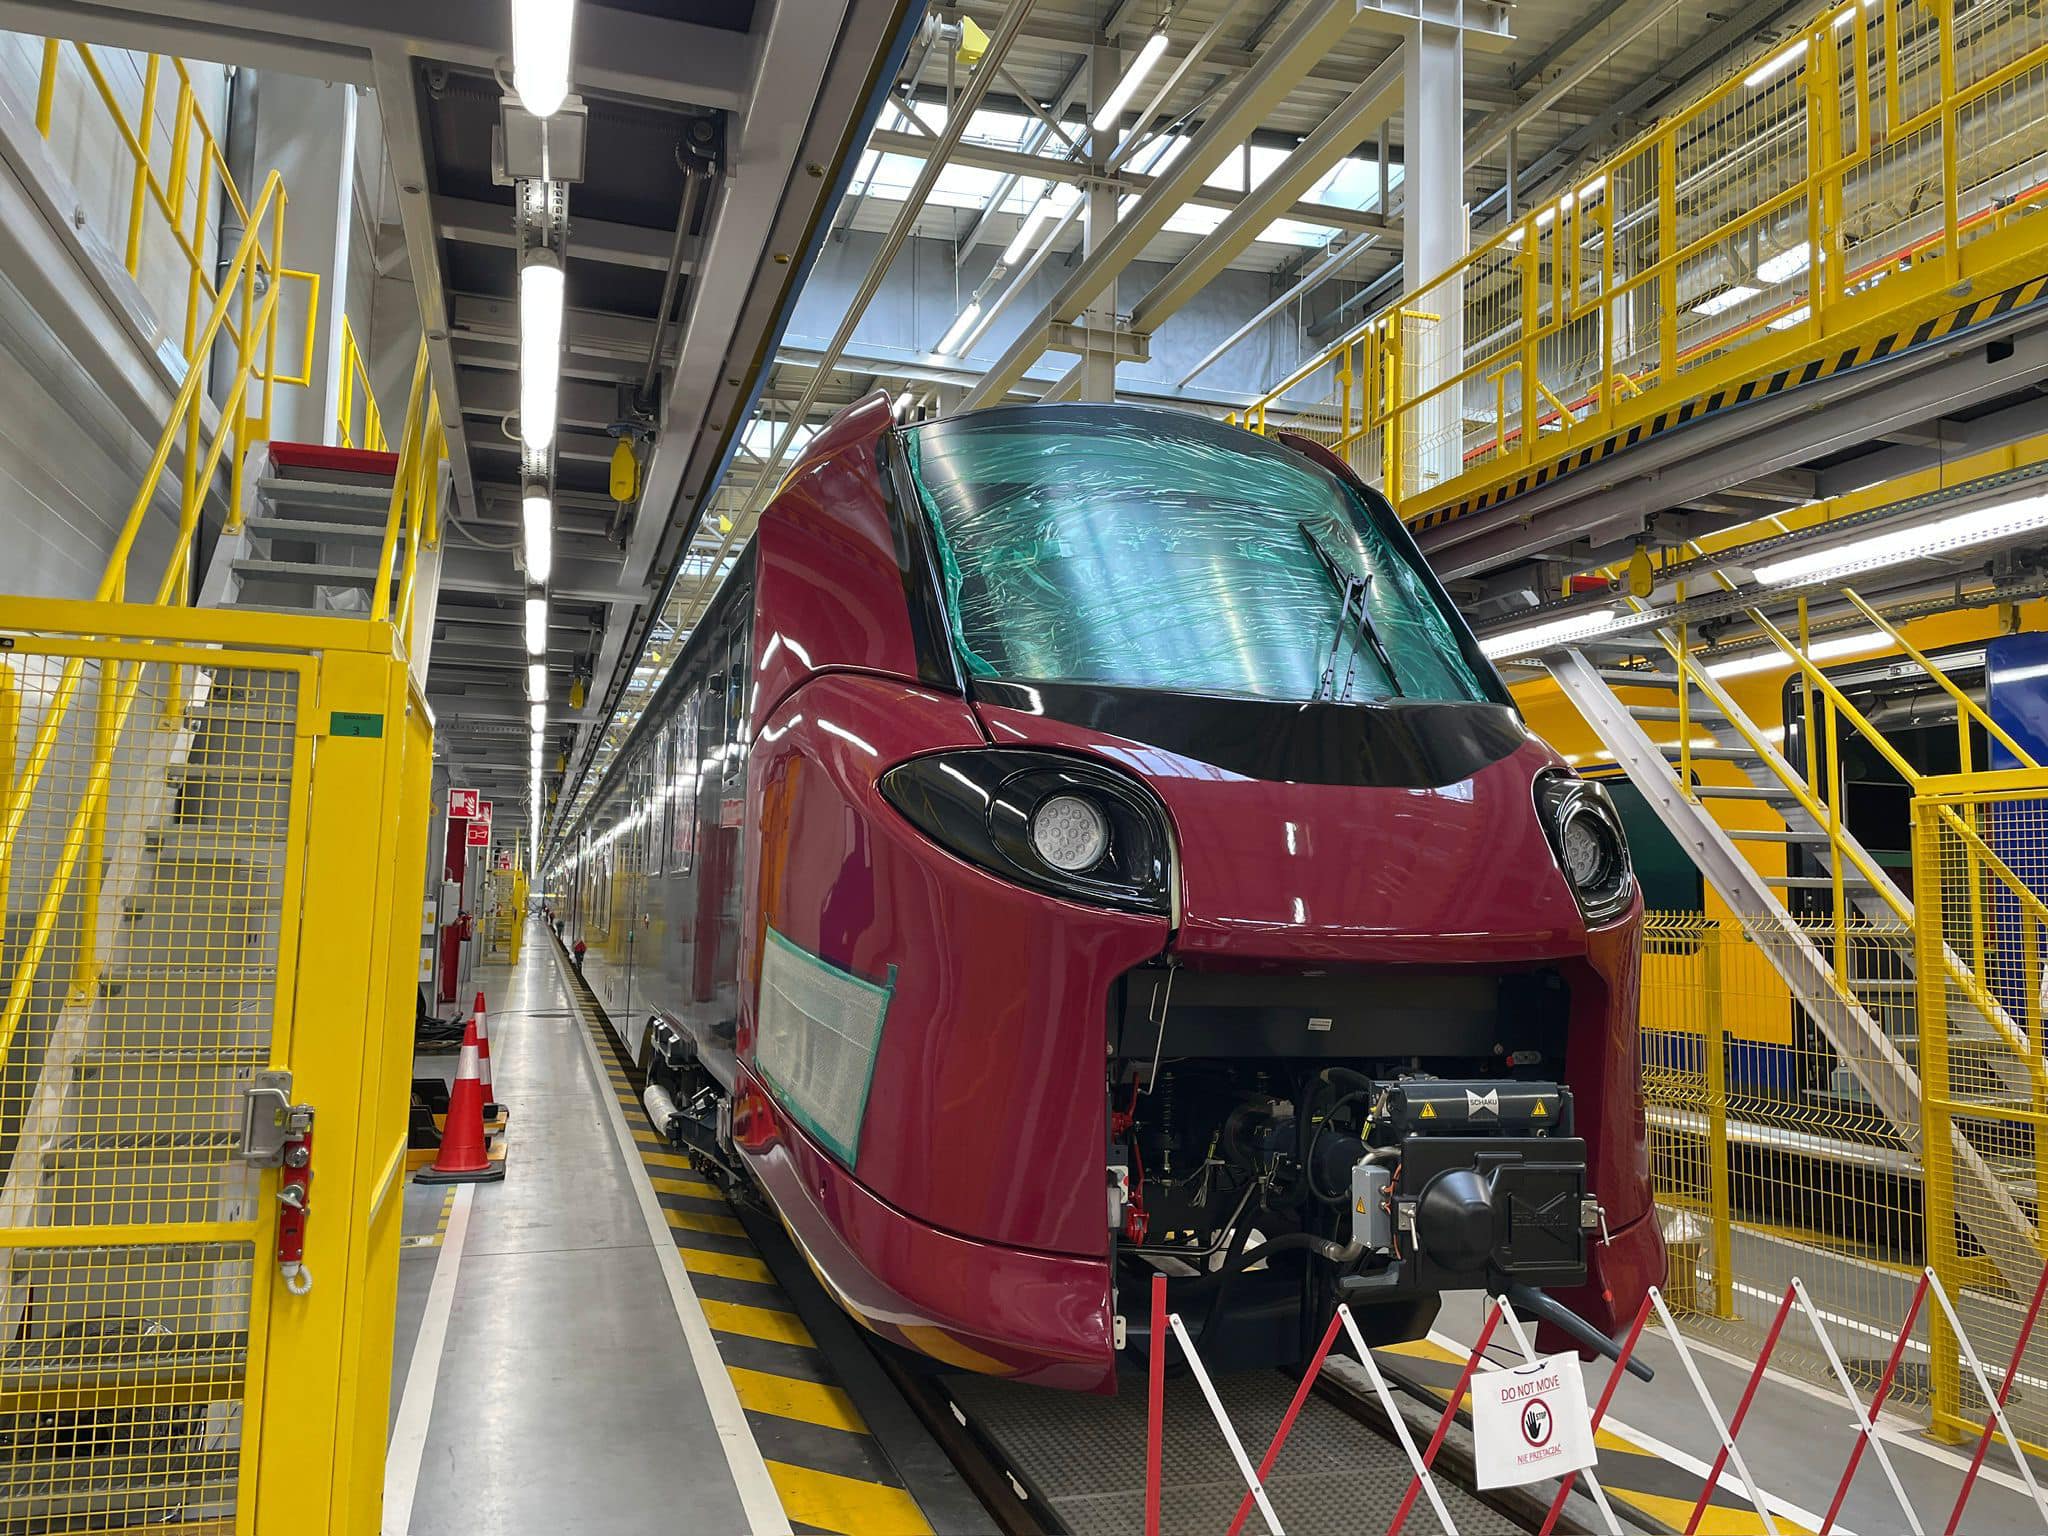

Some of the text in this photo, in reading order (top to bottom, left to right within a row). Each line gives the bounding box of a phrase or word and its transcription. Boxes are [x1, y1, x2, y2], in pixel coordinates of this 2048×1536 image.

[353, 726, 360, 736] 3
[1501, 1375, 1560, 1401] DO NOT MOVE
[1535, 1411, 1547, 1421] STOP
[1517, 1453, 1529, 1464] NIE
